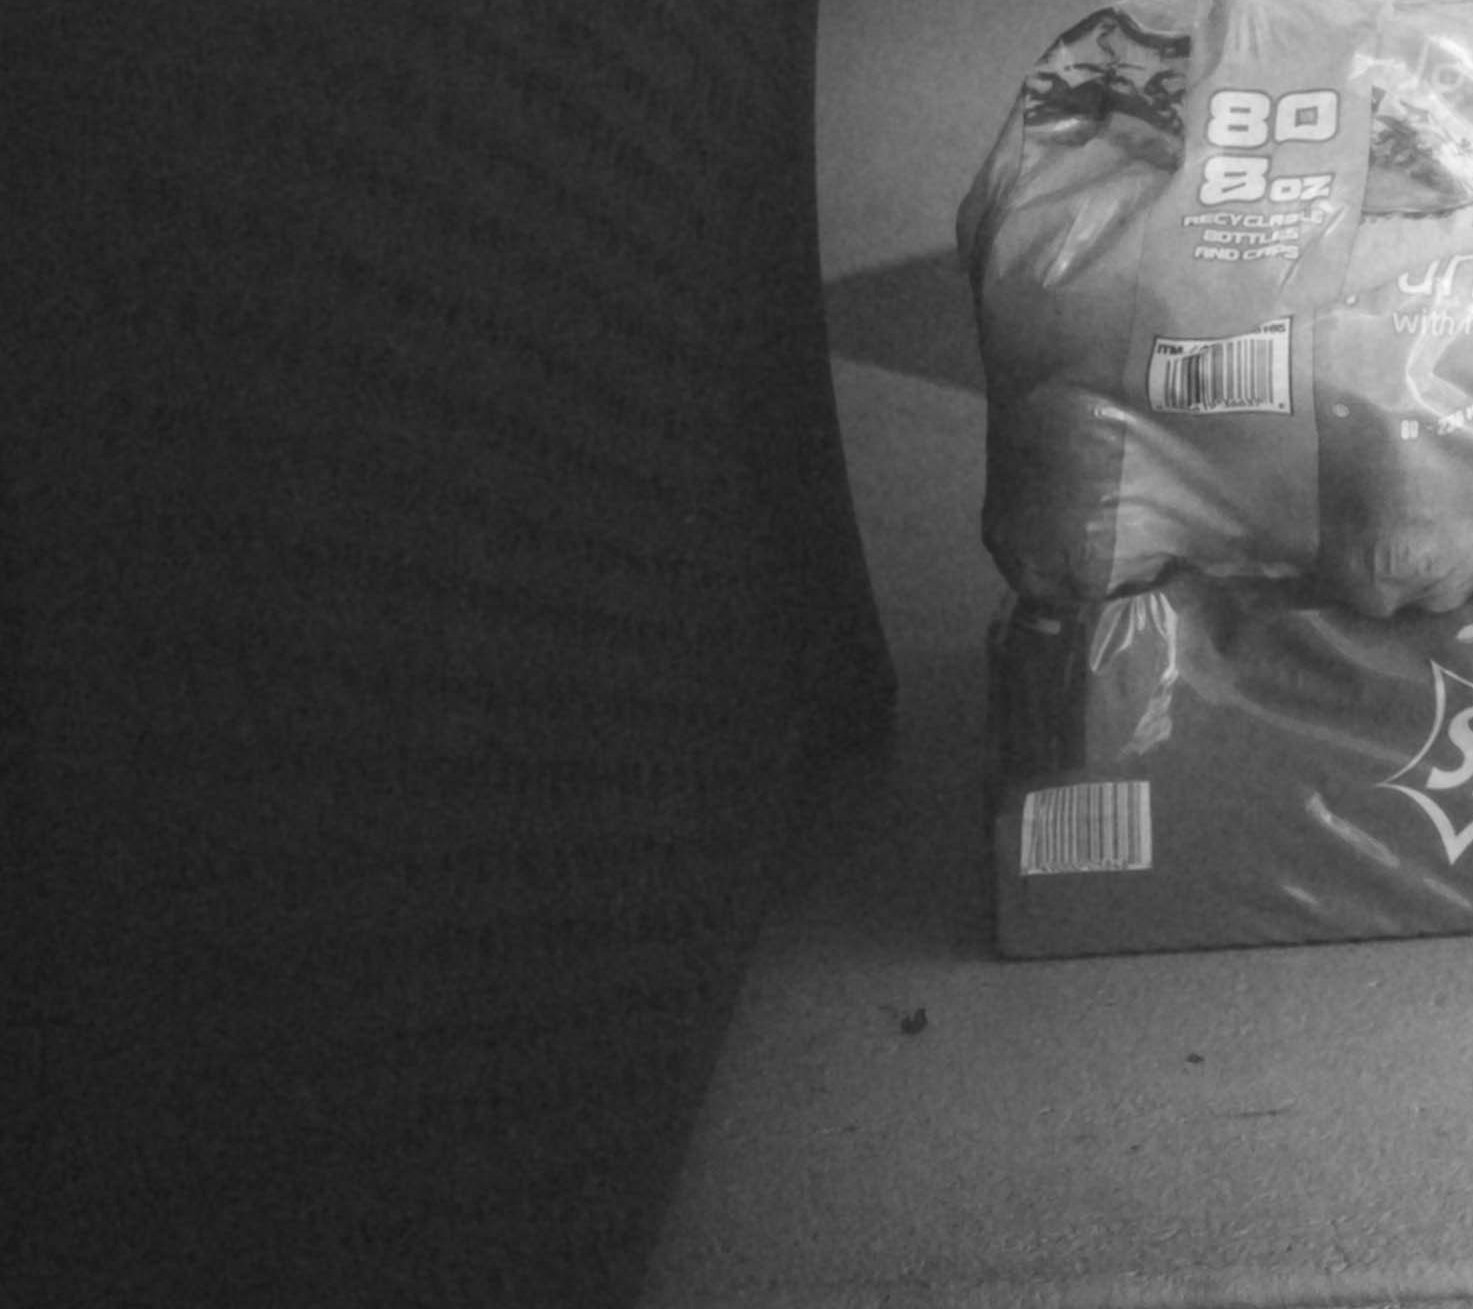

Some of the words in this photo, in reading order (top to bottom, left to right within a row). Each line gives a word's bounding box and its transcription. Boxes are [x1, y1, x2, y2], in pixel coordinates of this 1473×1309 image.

[1207, 89, 1339, 148] 80
[1202, 227, 1299, 245] BOTTLES
[1194, 245, 1240, 261] AND
[1242, 243, 1300, 260] CAPS
